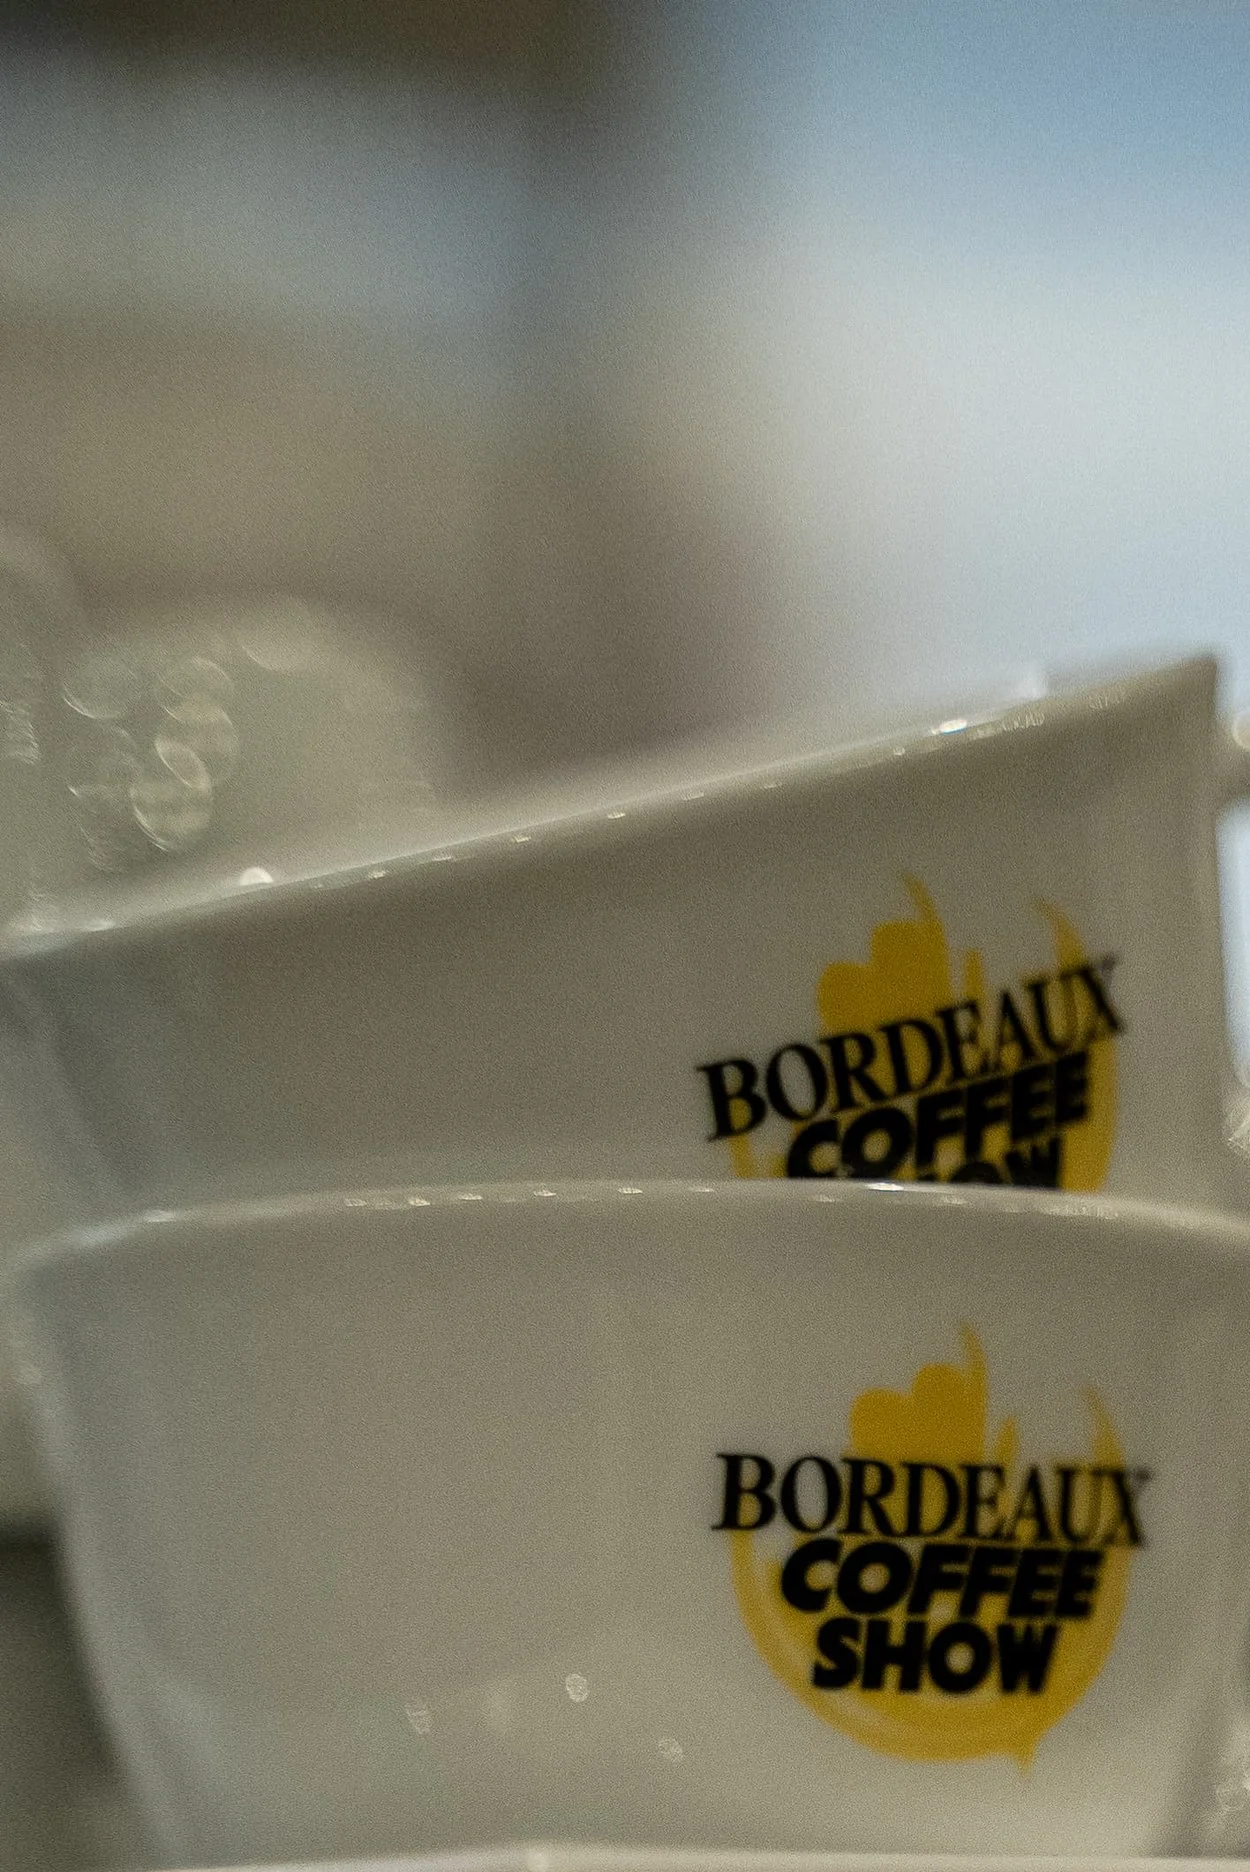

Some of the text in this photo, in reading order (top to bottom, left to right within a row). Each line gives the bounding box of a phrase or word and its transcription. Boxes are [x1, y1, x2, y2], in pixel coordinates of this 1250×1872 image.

[697, 950, 1126, 1142] BORDEAUX
[786, 1050, 1091, 1181] COFFEE
[711, 1451, 1153, 1549] BORDEAUX
[780, 1537, 1106, 1622] COFFEE
[811, 1615, 1058, 1695] SHOW
